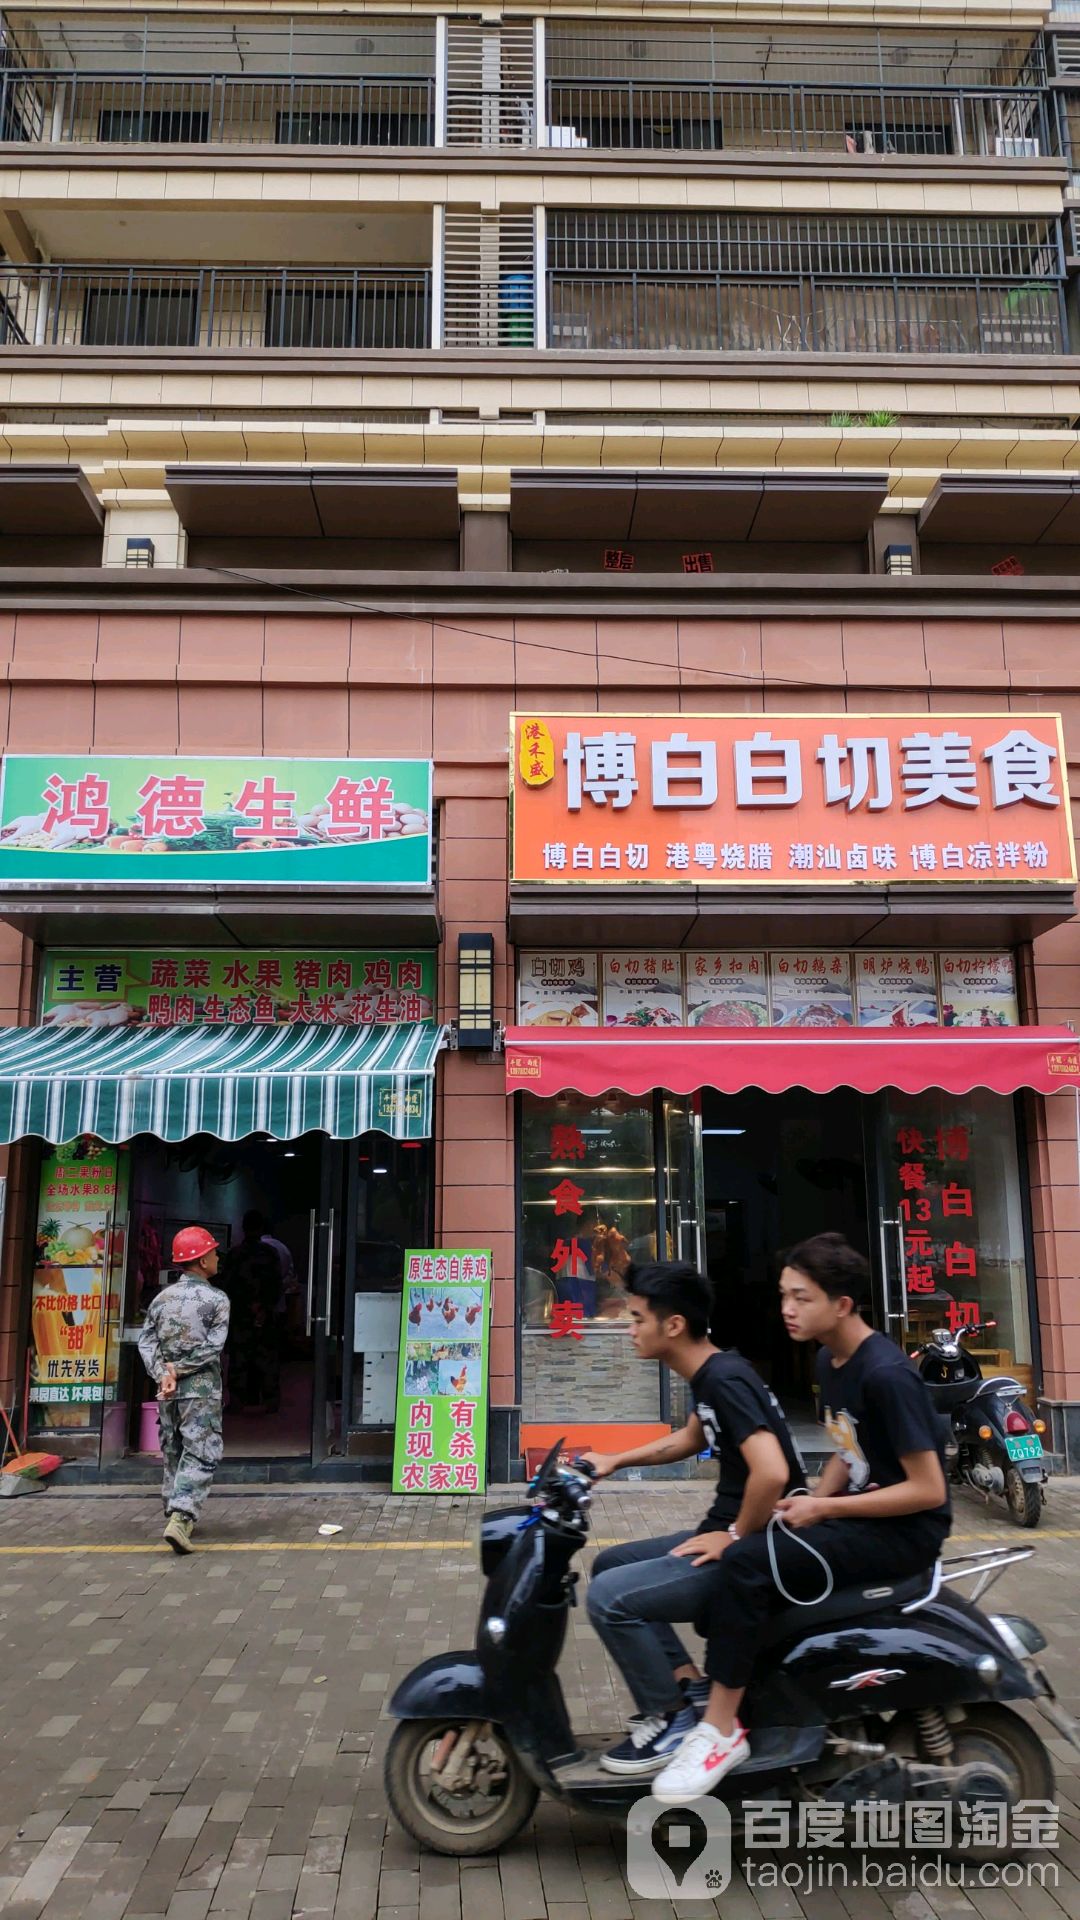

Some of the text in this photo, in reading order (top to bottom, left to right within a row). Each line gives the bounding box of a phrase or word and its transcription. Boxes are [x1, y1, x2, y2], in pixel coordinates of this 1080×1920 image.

[684, 554, 713, 573] 出售
[562, 730, 1061, 811] 博白白切美食
[41, 773, 395, 840] 鸿德生鲜
[543, 841, 1049, 870] 博白白切 港粤烧腊 潮汕卤味 博白凉拌粉
[57, 965, 122, 992] 主营
[151, 960, 422, 989] 蔬菜 水果 猪肉 鸡肉
[531, 957, 585, 977] 白切鸡
[609, 958, 675, 975] 白切猪肚
[694, 956, 760, 975] 家乡扣肉
[778, 957, 843, 975] 白切鹅杂
[863, 957, 930, 975] 明炉烧鸭
[149, 994, 422, 1025] 鸭肉 生态鱼 大米 花生油
[896, 1126, 936, 1294] 快餐13元起
[935, 1125, 980, 1337] 博白白切
[408, 1255, 488, 1282] 原生态自养鸡
[36, 1294, 78, 1311] 不比价格
[47, 1359, 100, 1378] 优先发货
[29, 1386, 69, 1402] 果园直达
[401, 1463, 478, 1491] 农家鸡
